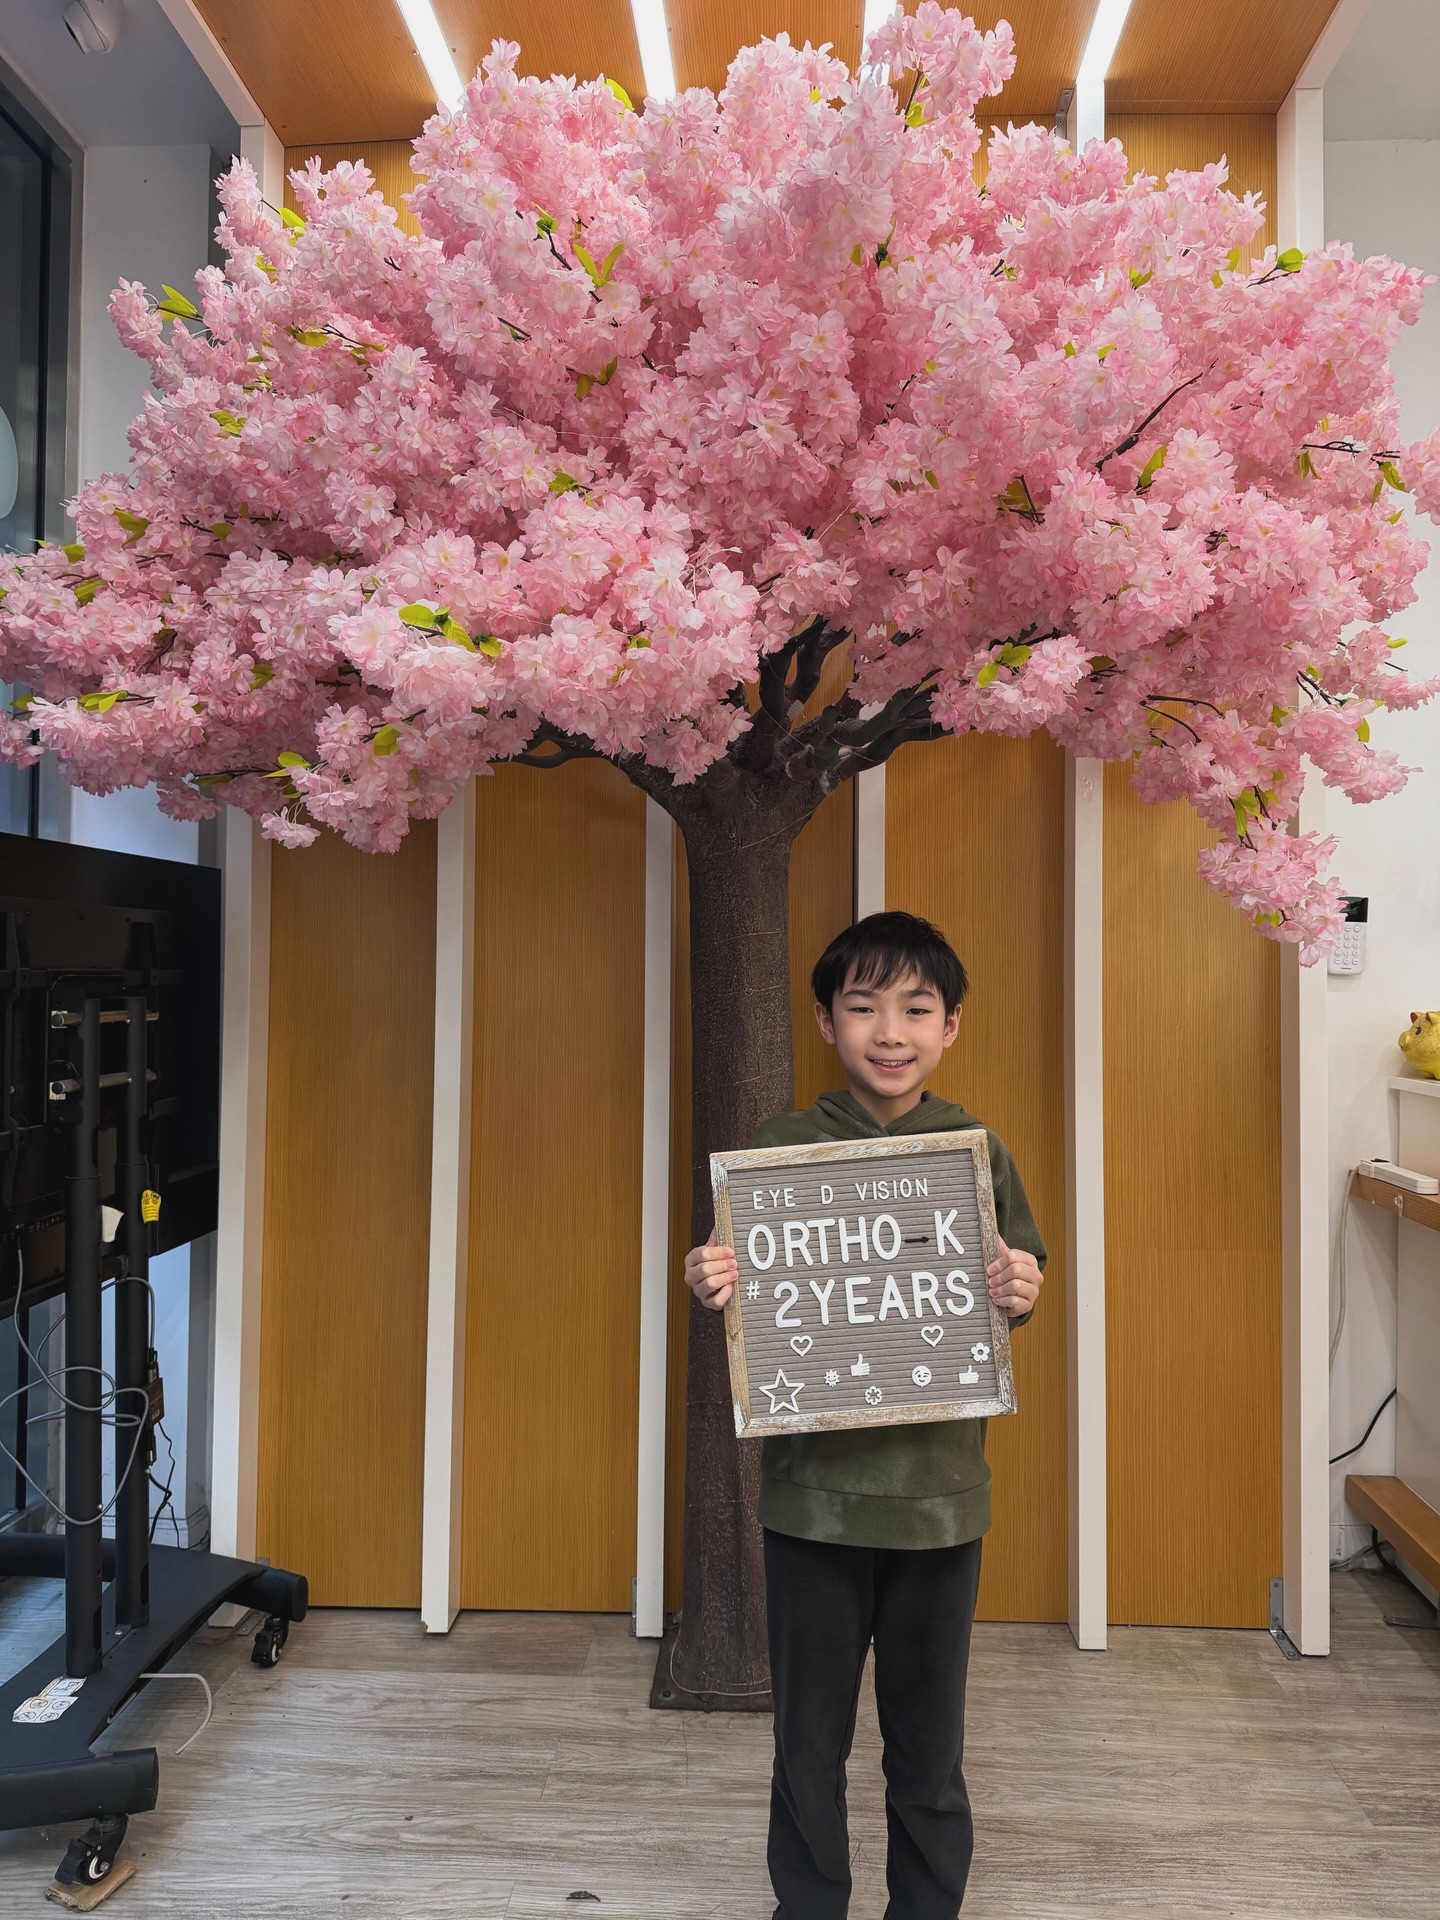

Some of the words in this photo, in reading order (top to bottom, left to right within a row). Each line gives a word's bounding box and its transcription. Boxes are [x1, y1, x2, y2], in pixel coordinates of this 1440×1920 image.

[752, 1187, 797, 1210] EYE
[820, 1184, 834, 1205] D
[854, 1177, 929, 1202] VISION
